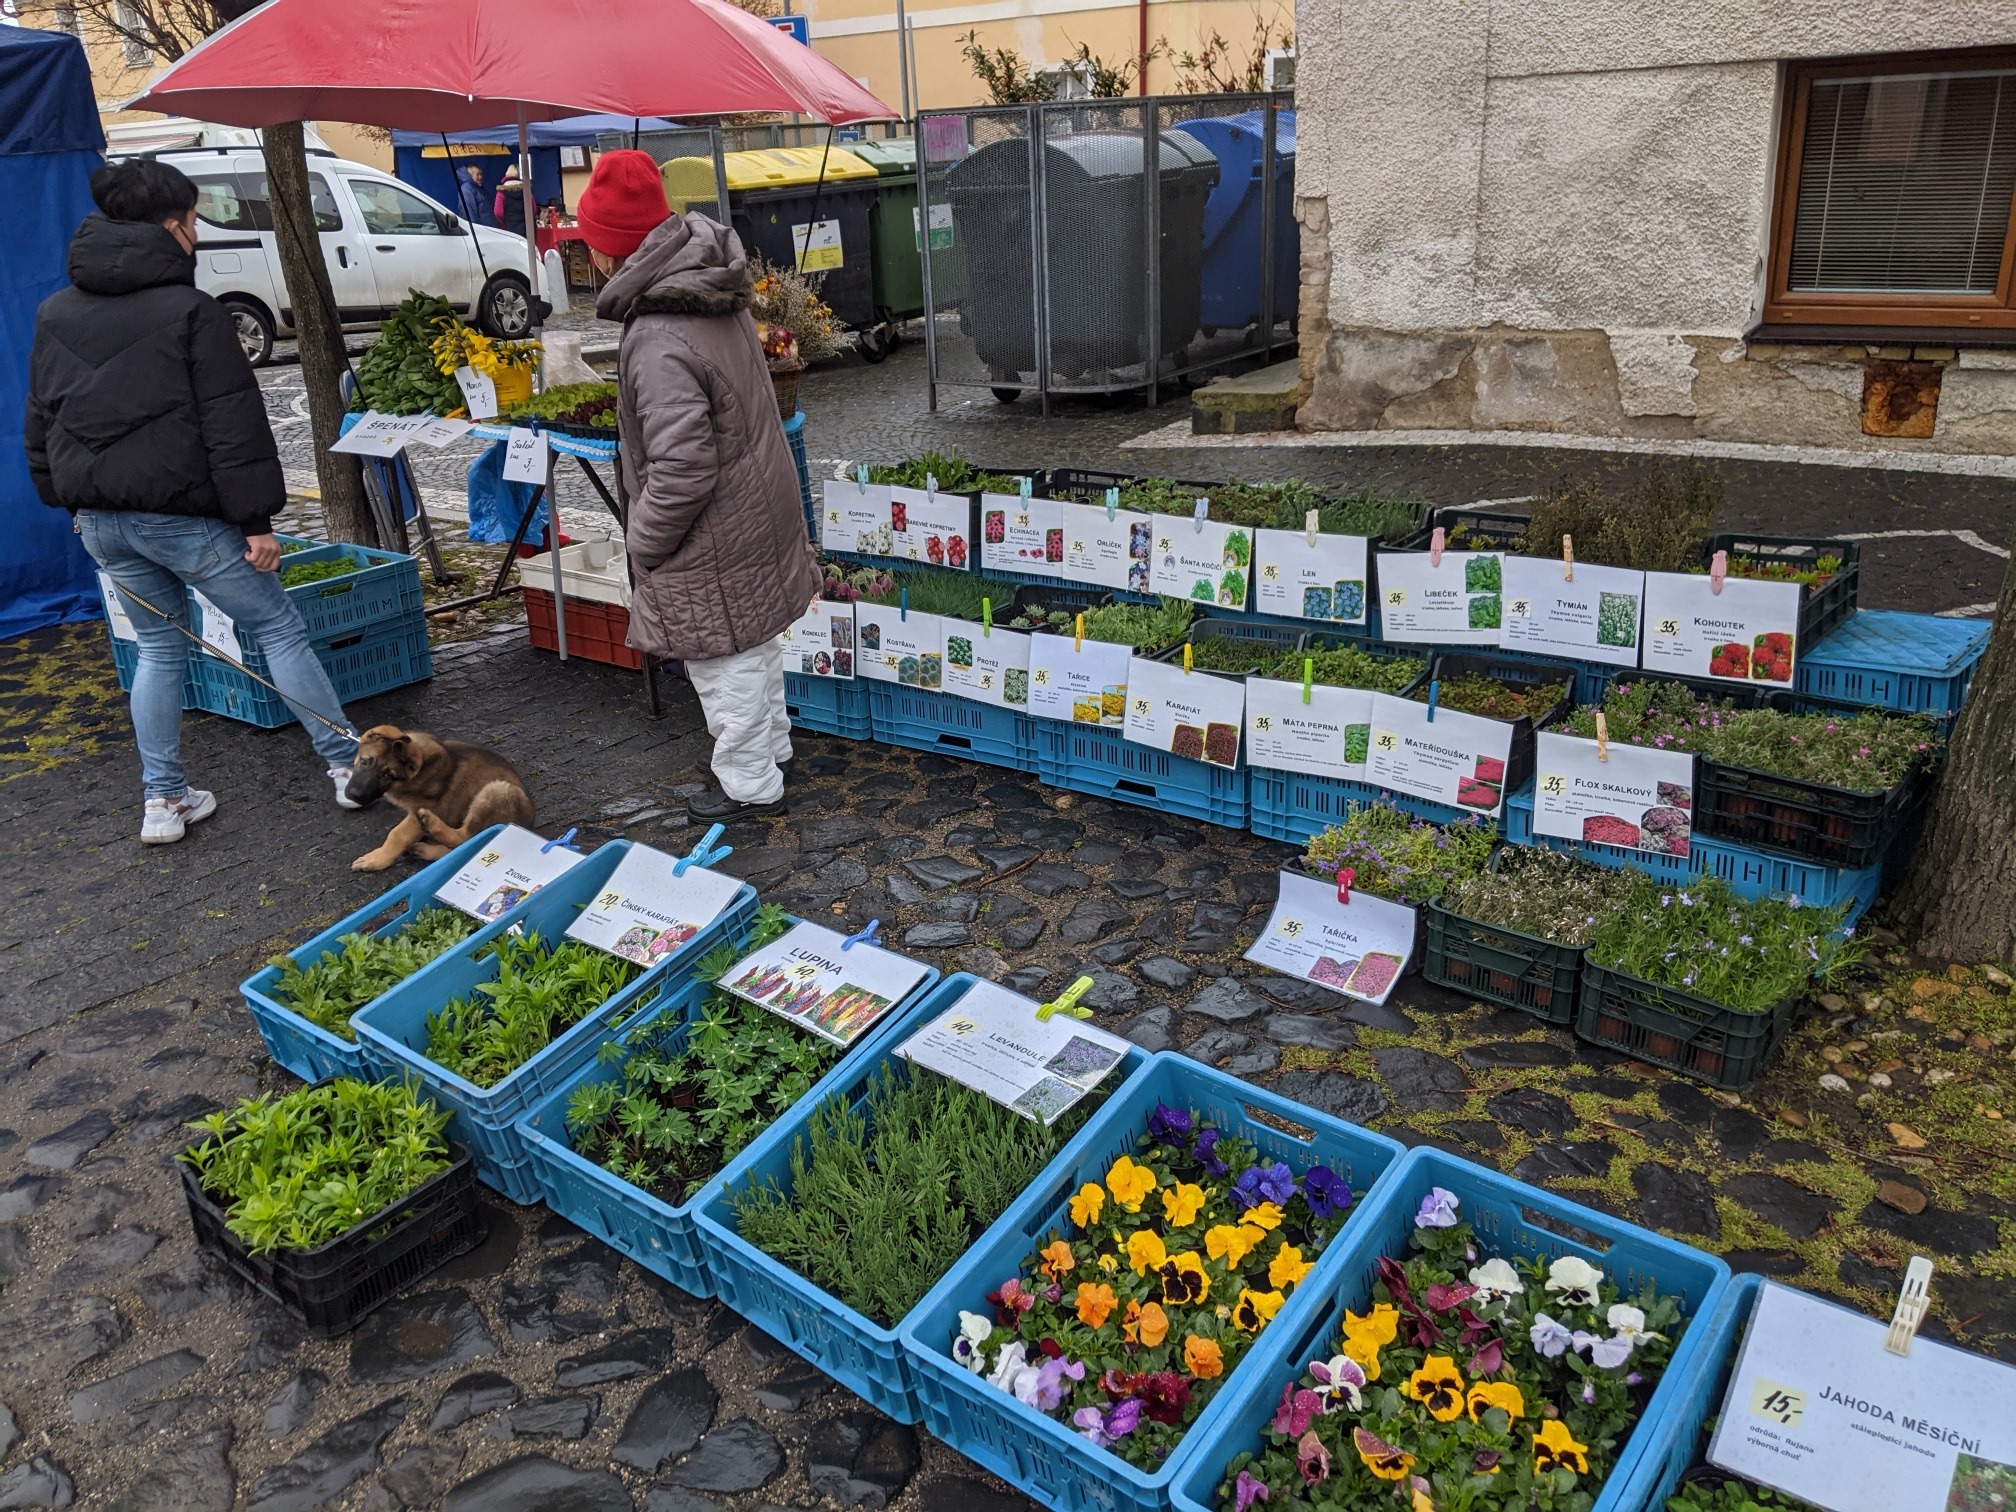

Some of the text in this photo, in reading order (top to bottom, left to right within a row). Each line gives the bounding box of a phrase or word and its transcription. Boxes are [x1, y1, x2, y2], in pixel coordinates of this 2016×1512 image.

[366, 420, 417, 431] ŠPENÁT
[848, 510, 875, 518] KOPRETINA
[907, 518, 956, 532] BAREVNÉ KOPRETINY
[1009, 527, 1040, 536] ECHINACEA
[1096, 539, 1122, 549] ORLÍČEK
[1180, 557, 1222, 571] ŠANTA KOČIČÍ
[1302, 569, 1316, 577] LEN
[1424, 590, 1458, 598] LIBEČEK
[1557, 600, 1587, 611] TYMIÁN
[1694, 617, 1745, 630] KOHOUTEK
[802, 629, 827, 638] KONIKLEC
[886, 638, 916, 649] KOSTŘAVA
[977, 656, 999, 667] PROTĚŽ
[1067, 671, 1091, 682] TAŘICE
[1166, 699, 1201, 715] KARAFIÁT
[1282, 718, 1339, 732] MÁTA PEPRNÁ
[1404, 737, 1470, 761] MATEŘÍDOUŠKA
[1574, 778, 1652, 797] FLOX SKALKOVÝ
[505, 868, 532, 884] ZVONEK
[621, 899, 679, 926] ČÍNSKÝ KARAFIÁT
[1322, 925, 1358, 943] TAŘIČKA
[789, 947, 844, 976] LUPINA
[989, 1032, 1046, 1062] LEVANDULE
[1762, 1390, 1803, 1424] 15,-
[1819, 1386, 1981, 1454] JAHODA MĚSÍČNÍ
[1749, 1424, 1814, 1454] odrůda: Rujana
[1850, 1421, 1936, 1459] stáleplodící jahoda
[1746, 1436, 1802, 1461] výborná chuť
